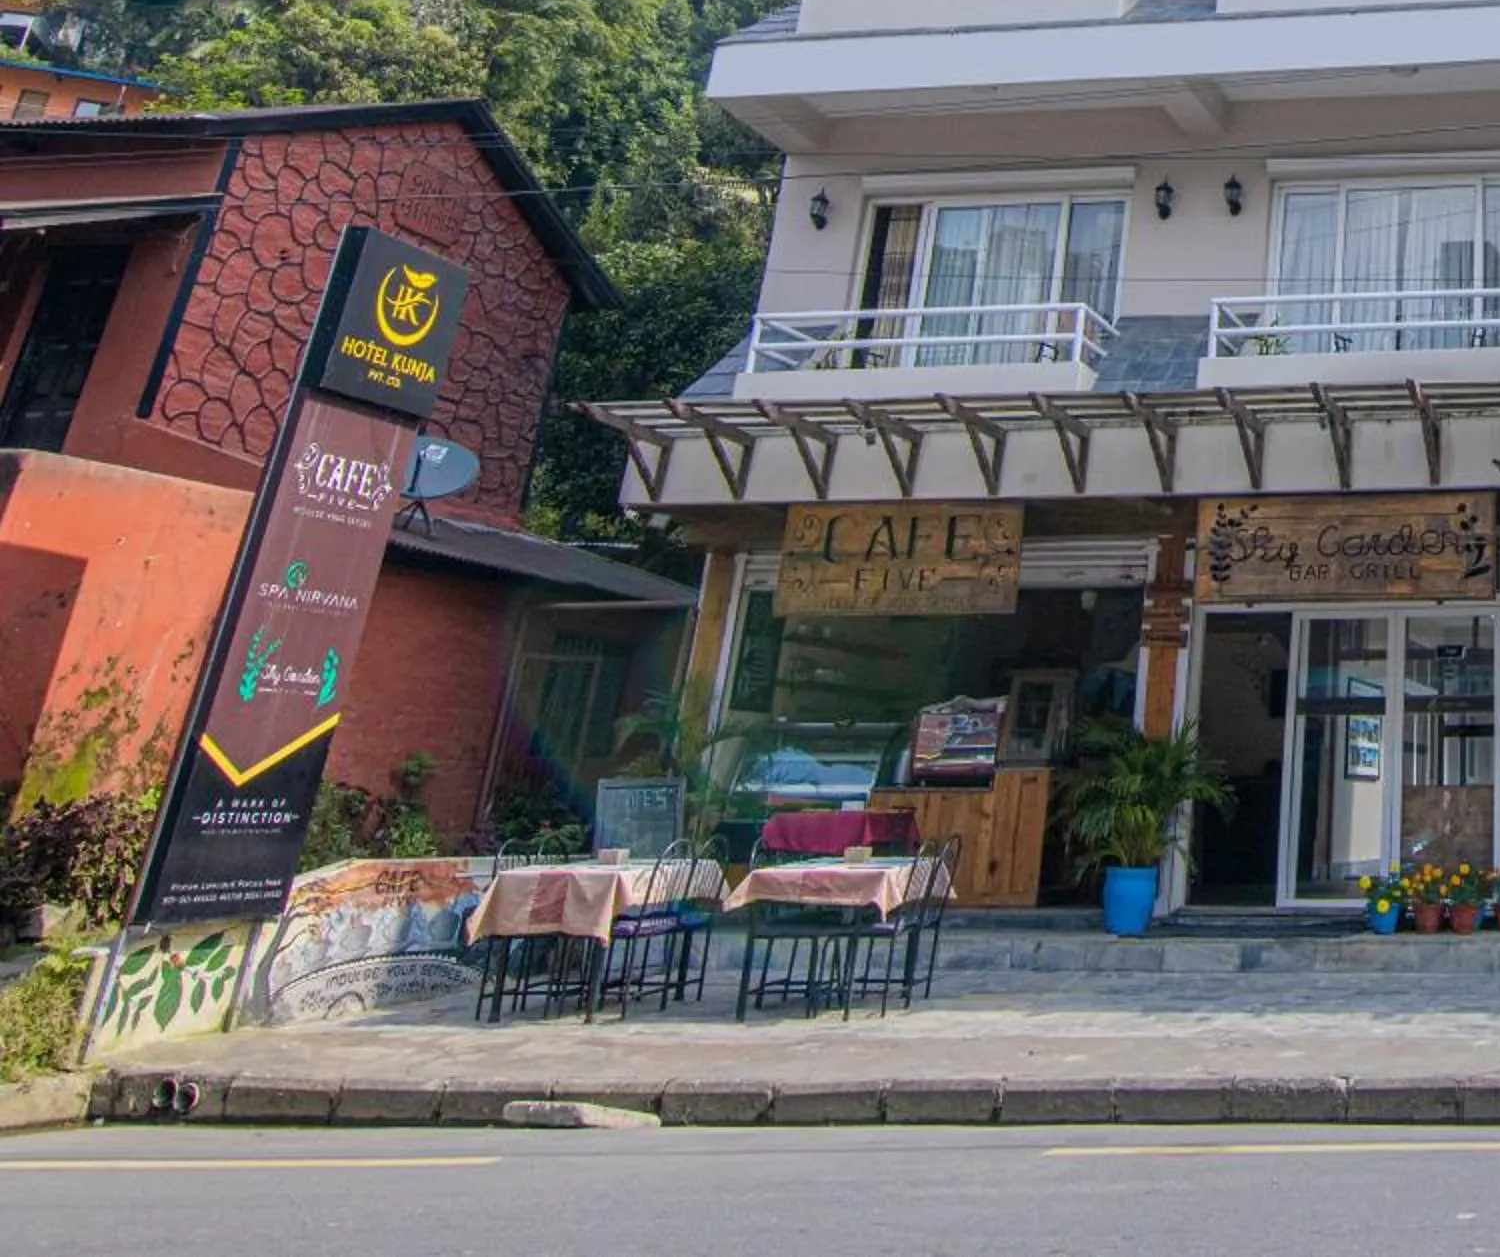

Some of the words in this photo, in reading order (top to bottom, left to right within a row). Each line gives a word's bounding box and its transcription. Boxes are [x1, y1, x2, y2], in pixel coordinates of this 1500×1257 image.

[341, 335, 389, 367] HOTEL
[391, 352, 437, 384] KUNJA
[315, 454, 378, 500] CAFE
[824, 514, 983, 563] CAFE
[1229, 526, 1299, 569] Sky
[1317, 524, 1467, 558] Garden
[854, 567, 936, 593] FIVE
[1289, 564, 1329, 582] BAR
[1350, 562, 1422, 580] GRILL
[259, 583, 289, 599] SPA
[295, 589, 358, 610] NIRVANA
[216, 798, 223, 808] A
[231, 798, 265, 808] MARK
[201, 812, 291, 824] DISTINCTION
